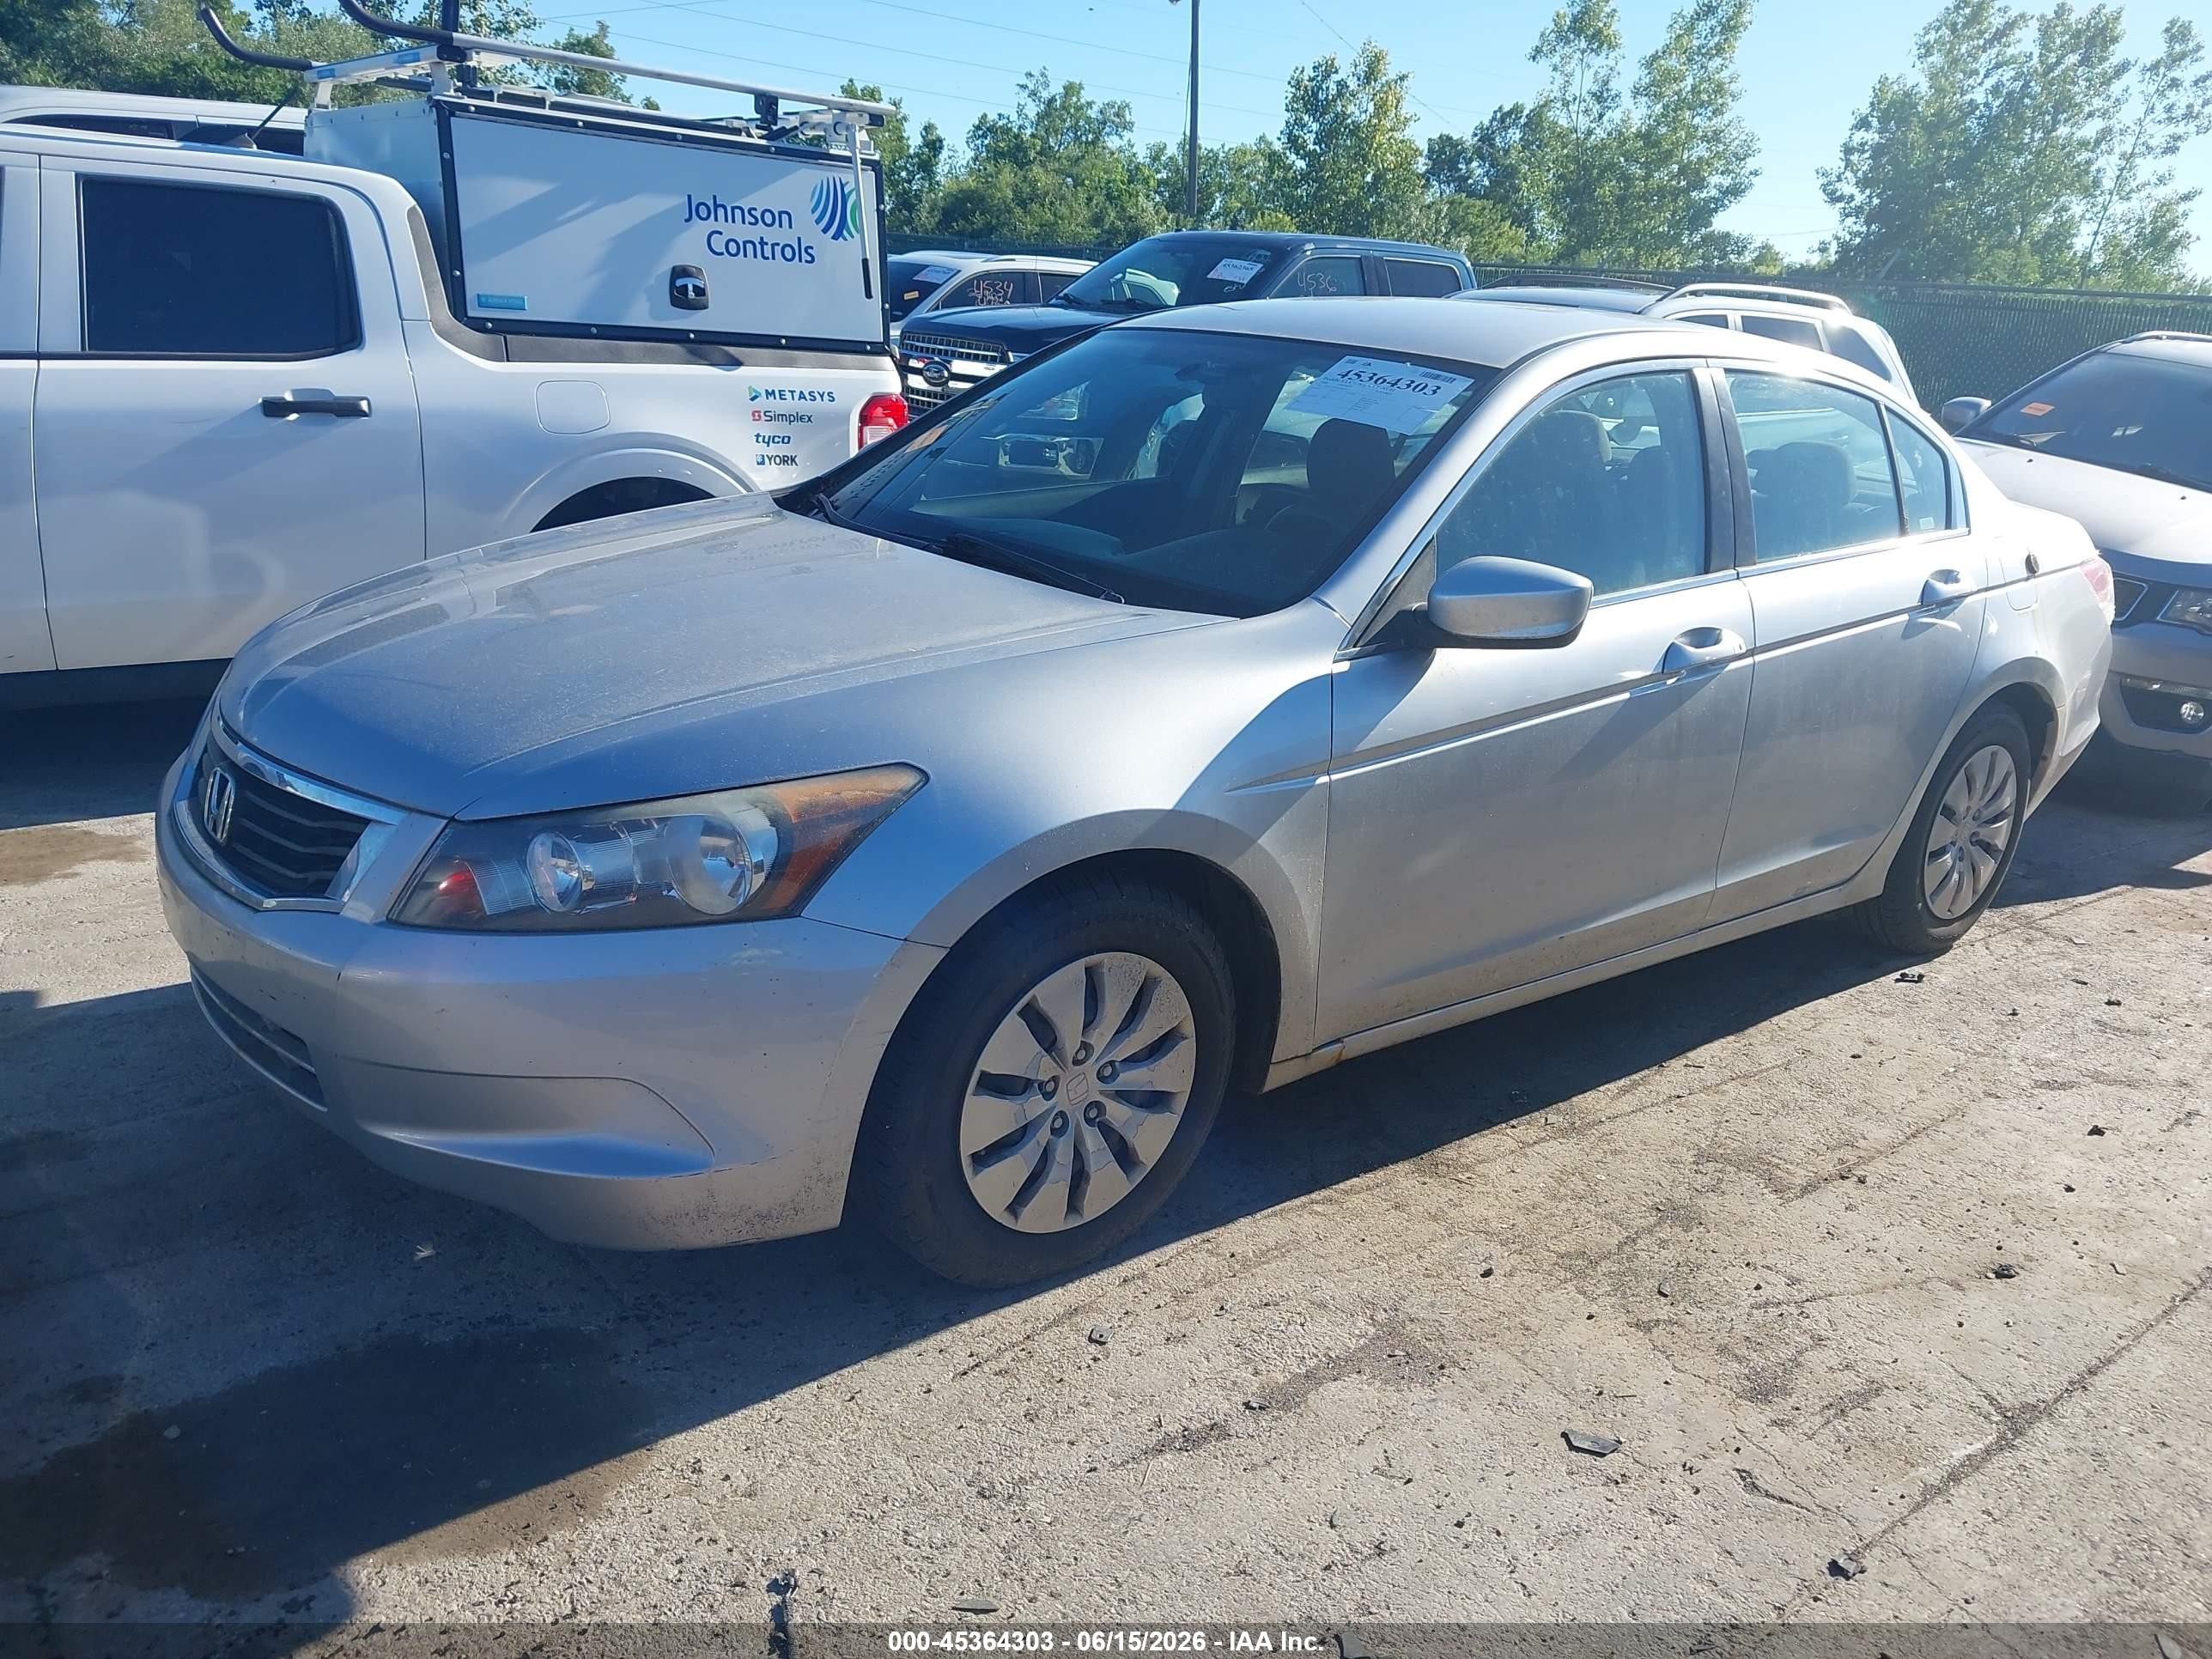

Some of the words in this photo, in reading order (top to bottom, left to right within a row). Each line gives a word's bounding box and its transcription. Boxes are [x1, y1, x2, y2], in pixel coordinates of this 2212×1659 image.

[684, 194, 793, 229] Johnson
[706, 229, 816, 264] Controls
[973, 279, 1013, 300] 4534
[1297, 271, 1337, 293] 4536
[1337, 369, 1443, 397] 45364303
[764, 389, 836, 403] METASYS
[763, 410, 813, 425] Simplex
[754, 432, 791, 447] tyco
[766, 454, 799, 466] YORK
